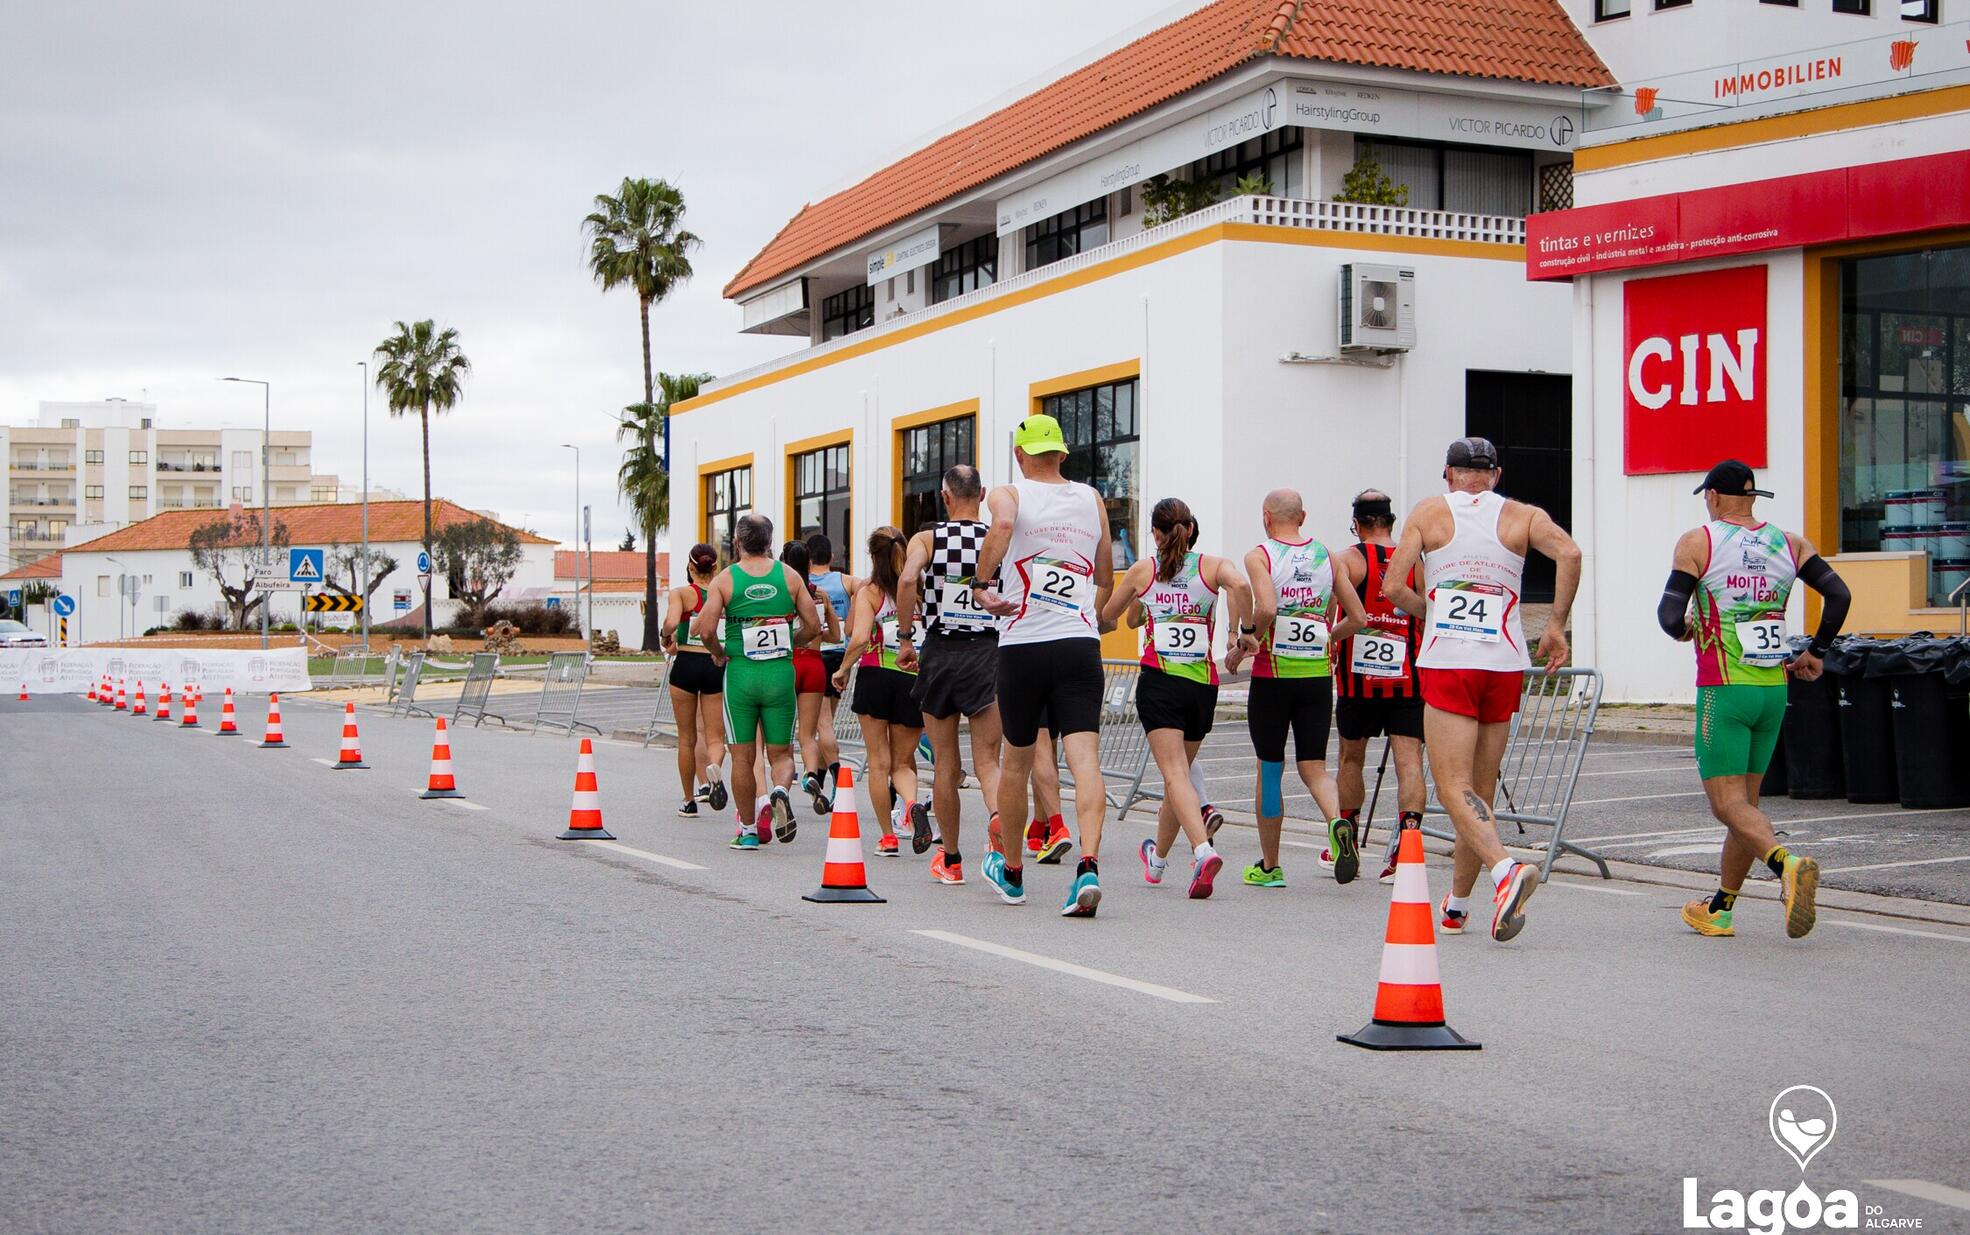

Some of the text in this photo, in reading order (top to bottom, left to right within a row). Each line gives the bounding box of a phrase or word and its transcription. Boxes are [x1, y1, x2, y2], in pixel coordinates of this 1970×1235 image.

[1714, 57, 1842, 99] IMMOBILIEN
[1296, 103, 1381, 125] HairstylingGroup
[1202, 112, 1259, 147] VICTOR PICARDO
[1449, 117, 1546, 140] VICTOR PICARDO
[1539, 223, 1655, 253] tintas e vernizes
[1539, 255, 1576, 269] construção
[1577, 252, 1591, 264] civil
[1595, 248, 1627, 260] indústria
[1627, 245, 1649, 257] metal
[1655, 241, 1685, 254] madeira
[1690, 235, 1726, 250] protecção
[1727, 227, 1778, 244] anti-corrosiva
[1628, 327, 1758, 410] CIN
[1431, 562, 1456, 576] CLUBE
[1473, 560, 1519, 578] ATLETISMO
[255, 580, 291, 589] Albufeira
[1042, 570, 1076, 598] 22
[1281, 586, 1313, 598] MOITA
[1727, 575, 1767, 589] MOITA
[1155, 592, 1189, 604] MOITA
[1448, 595, 1488, 623] 24
[1366, 612, 1408, 625] Sofima
[756, 628, 778, 648] 21
[1168, 626, 1196, 649] 39
[1287, 621, 1316, 643] 36
[1752, 625, 1781, 650] 35
[1363, 639, 1394, 662] 28
